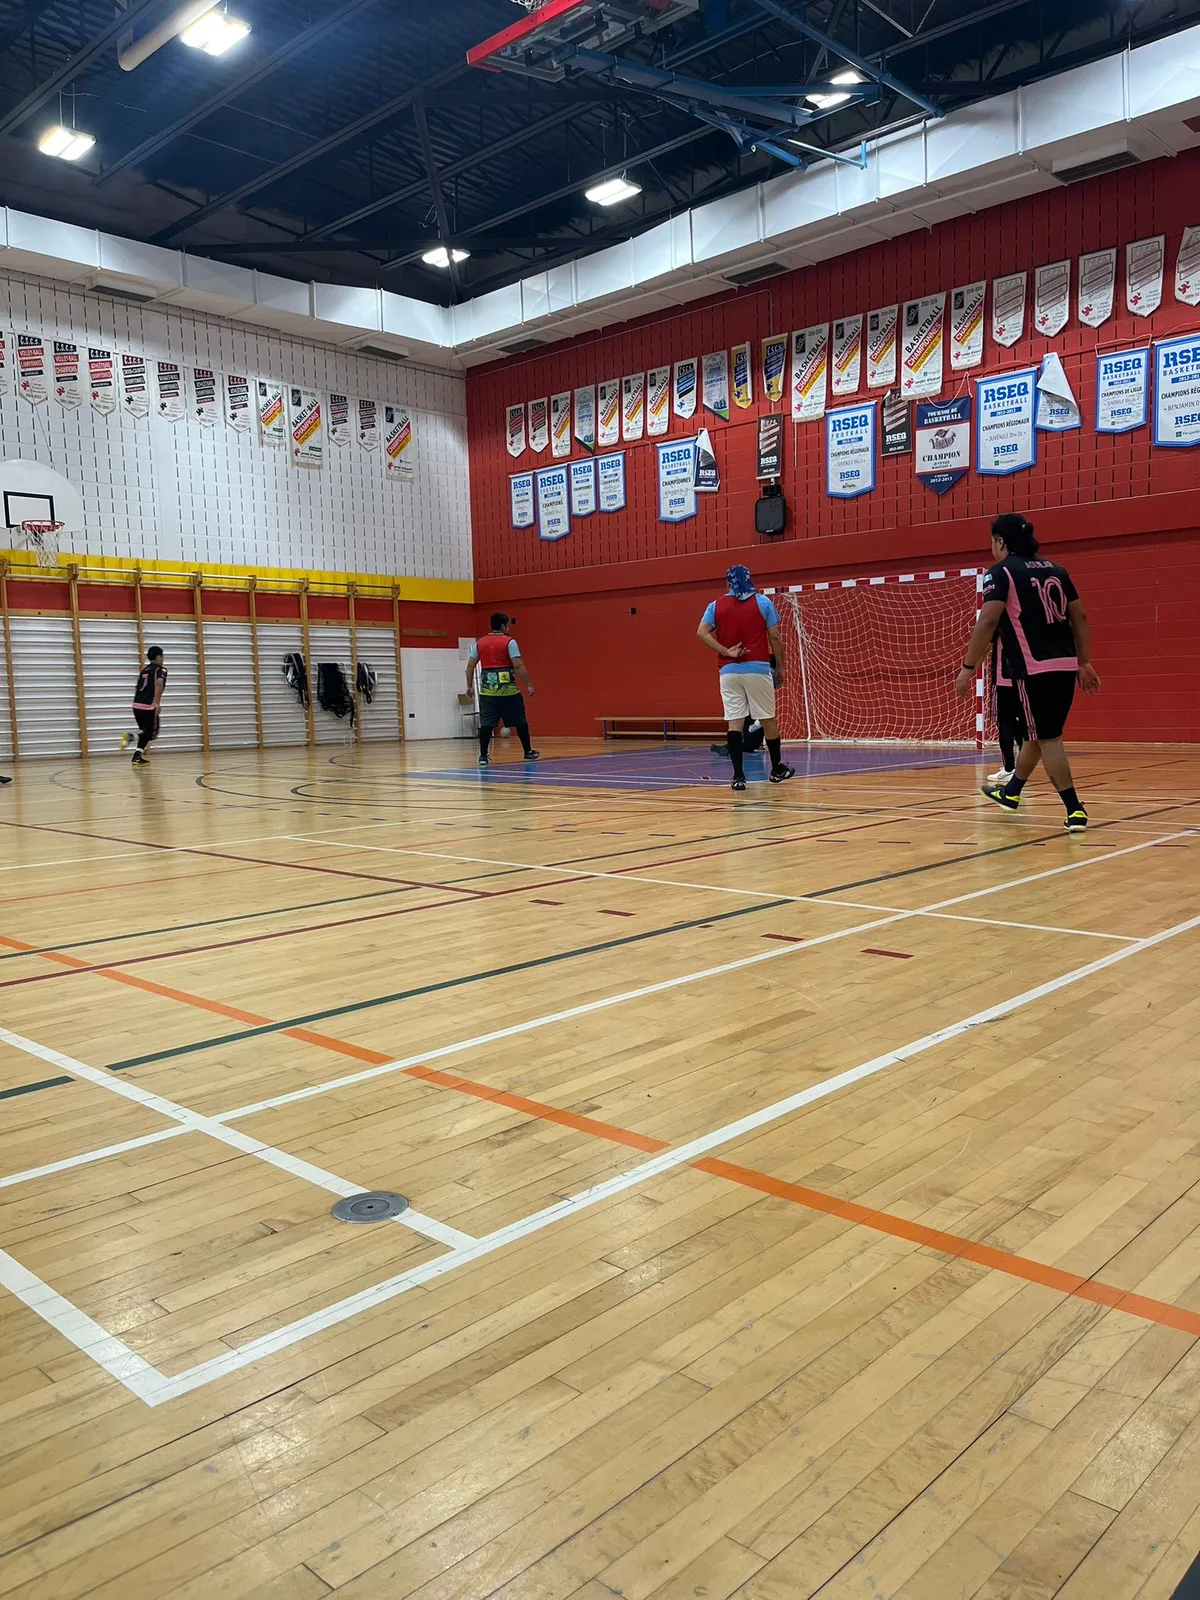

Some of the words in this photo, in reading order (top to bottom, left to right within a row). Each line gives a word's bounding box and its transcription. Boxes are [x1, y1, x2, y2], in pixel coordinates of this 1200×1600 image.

[953, 293, 983, 331] BASKETBALL
[955, 305, 982, 340] CHAMPIONS
[869, 316, 896, 351] FOOTBALL
[905, 306, 943, 353] BASKETBALL
[835, 325, 861, 359] BASKETBALL
[907, 322, 941, 367] CHAMPIONNES
[794, 335, 827, 379] BASKETBALL
[797, 351, 826, 391] CHAMPIONNES
[1103, 357, 1142, 375] RSEQ
[1103, 370, 1141, 381] BASKETBALL
[625, 382, 642, 410] VOLLEYBALL
[649, 376, 668, 404] FOOTBALL
[984, 382, 1029, 404] RSEQ
[1101, 389, 1124, 398] CHAMPIONS
[1130, 386, 1142, 394] LIGUE
[1161, 390, 1190, 399] CHAMPIONS
[984, 397, 1028, 411] BASKETBALL
[1168, 401, 1195, 411] BENJAMIN
[292, 398, 318, 428] BASKET-BALL
[927, 409, 950, 417] TOURNOI
[1111, 407, 1132, 417] RSEQ
[294, 411, 319, 438] CHAMPIONS
[832, 414, 869, 432] RSEQ
[924, 413, 962, 425] BASKETBALL
[982, 421, 1006, 431] CHAMPIONS
[1006, 418, 1030, 427] RÉGIONAUX
[385, 415, 409, 443] BASKETBALL
[831, 428, 868, 439] FOOTBALL
[886, 432, 907, 443] RSEQ
[830, 449, 850, 458] CHAMPIONS
[993, 443, 1018, 455] RSEQ
[662, 448, 691, 464] RSEQ
[760, 456, 777, 465] RSEQ
[922, 451, 961, 462] CHAMPION
[573, 465, 592, 476] RSEQ
[601, 459, 621, 471] RSEQ
[699, 469, 716, 477] RSEQ
[840, 469, 860, 479] RSEQ
[513, 479, 531, 489] RSEQ
[540, 474, 564, 488] RSEQ
[542, 500, 563, 508] CHAMPIONS
[669, 497, 685, 506] RSEQ
[547, 518, 561, 526] RSEQ
[1030, 576, 1068, 624] 10
